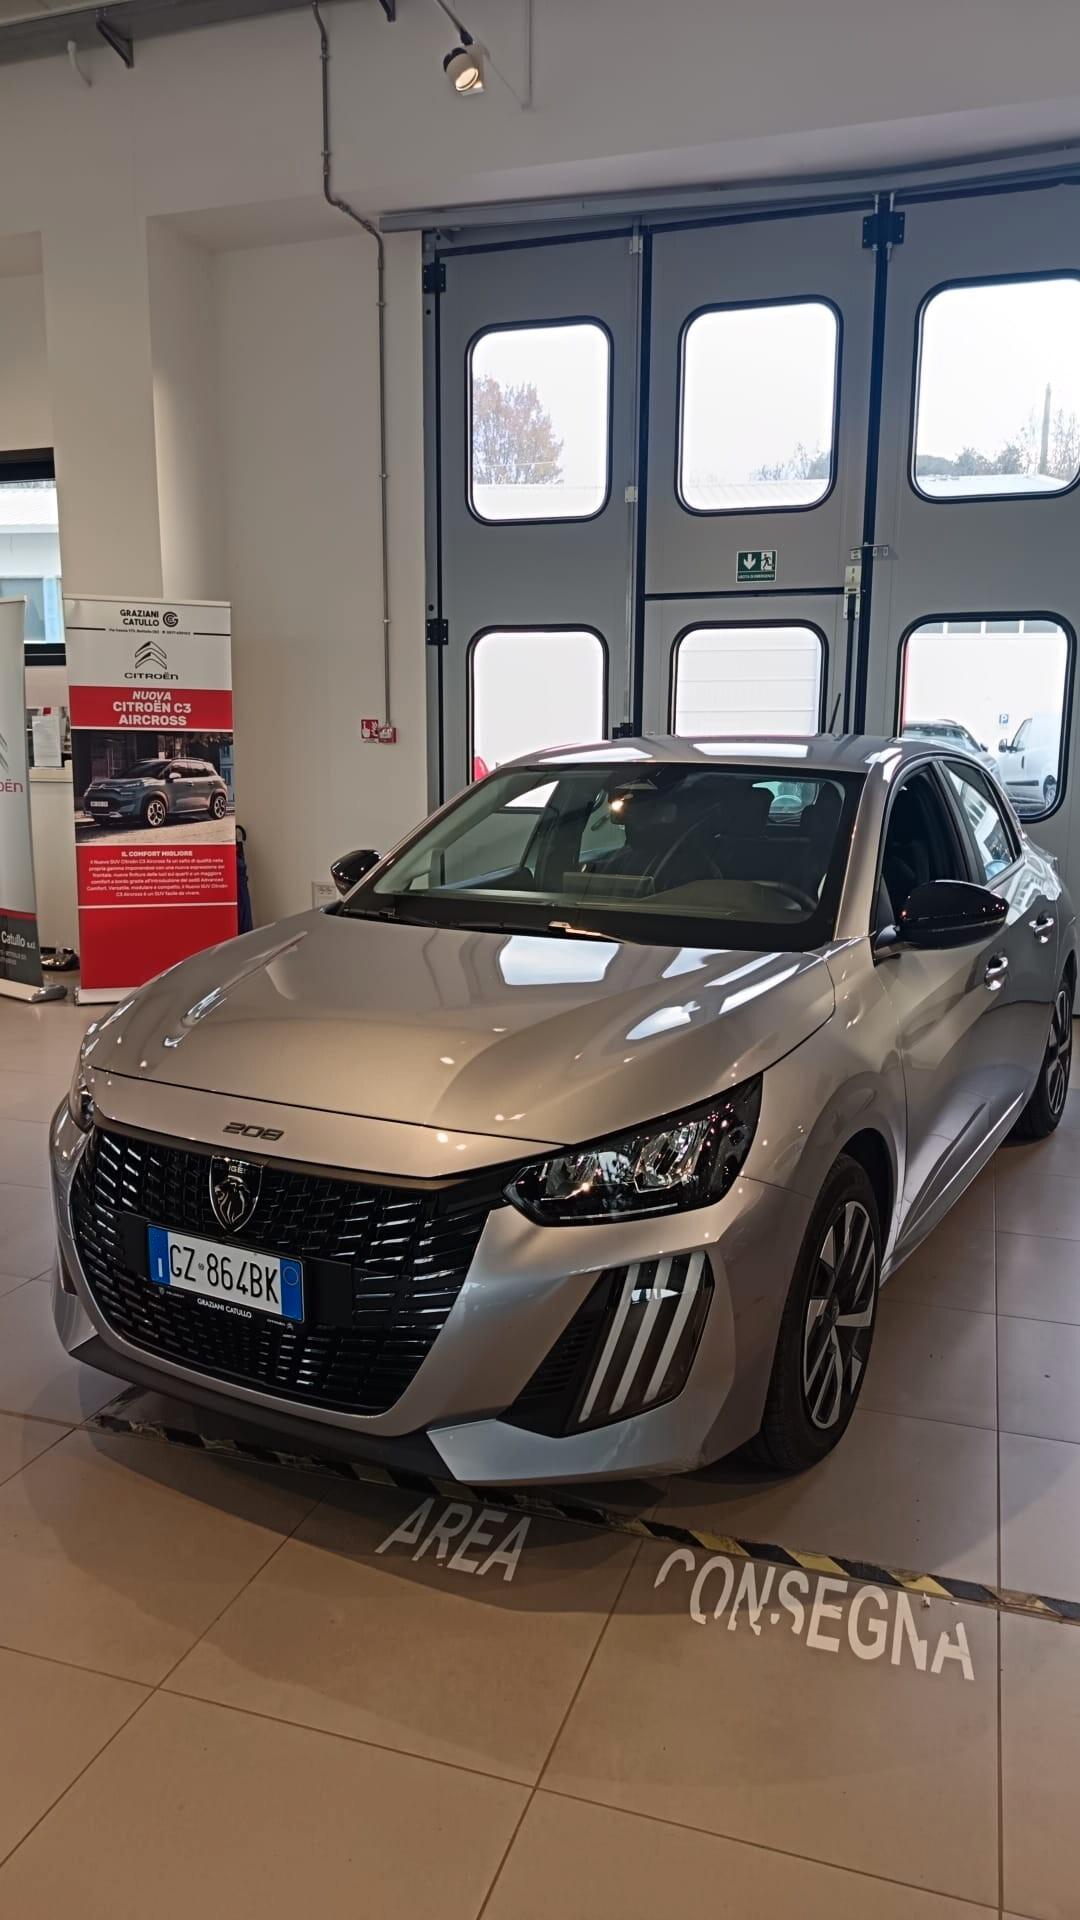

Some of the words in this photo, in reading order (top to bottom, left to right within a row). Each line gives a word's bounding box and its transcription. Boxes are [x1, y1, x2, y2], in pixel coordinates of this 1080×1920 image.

[120, 609, 159, 618] GRAZIANI
[123, 618, 159, 627] CATULLO
[124, 672, 179, 681] CITROËN
[132, 691, 172, 700] NUOVA
[113, 700, 172, 713] CITROËN
[174, 703, 192, 714] C3
[119, 714, 187, 726] AIRCROSS
[1, 930, 26, 947] Catullo
[223, 1121, 284, 1141] 208
[170, 1244, 196, 1282] GZ
[206, 1252, 280, 1304] 864BK
[197, 1298, 225, 1312] GRAZIANI
[226, 1304, 252, 1319] CATULLO
[375, 1497, 532, 1582] AREA
[653, 1548, 977, 1681] CONSEGNA
